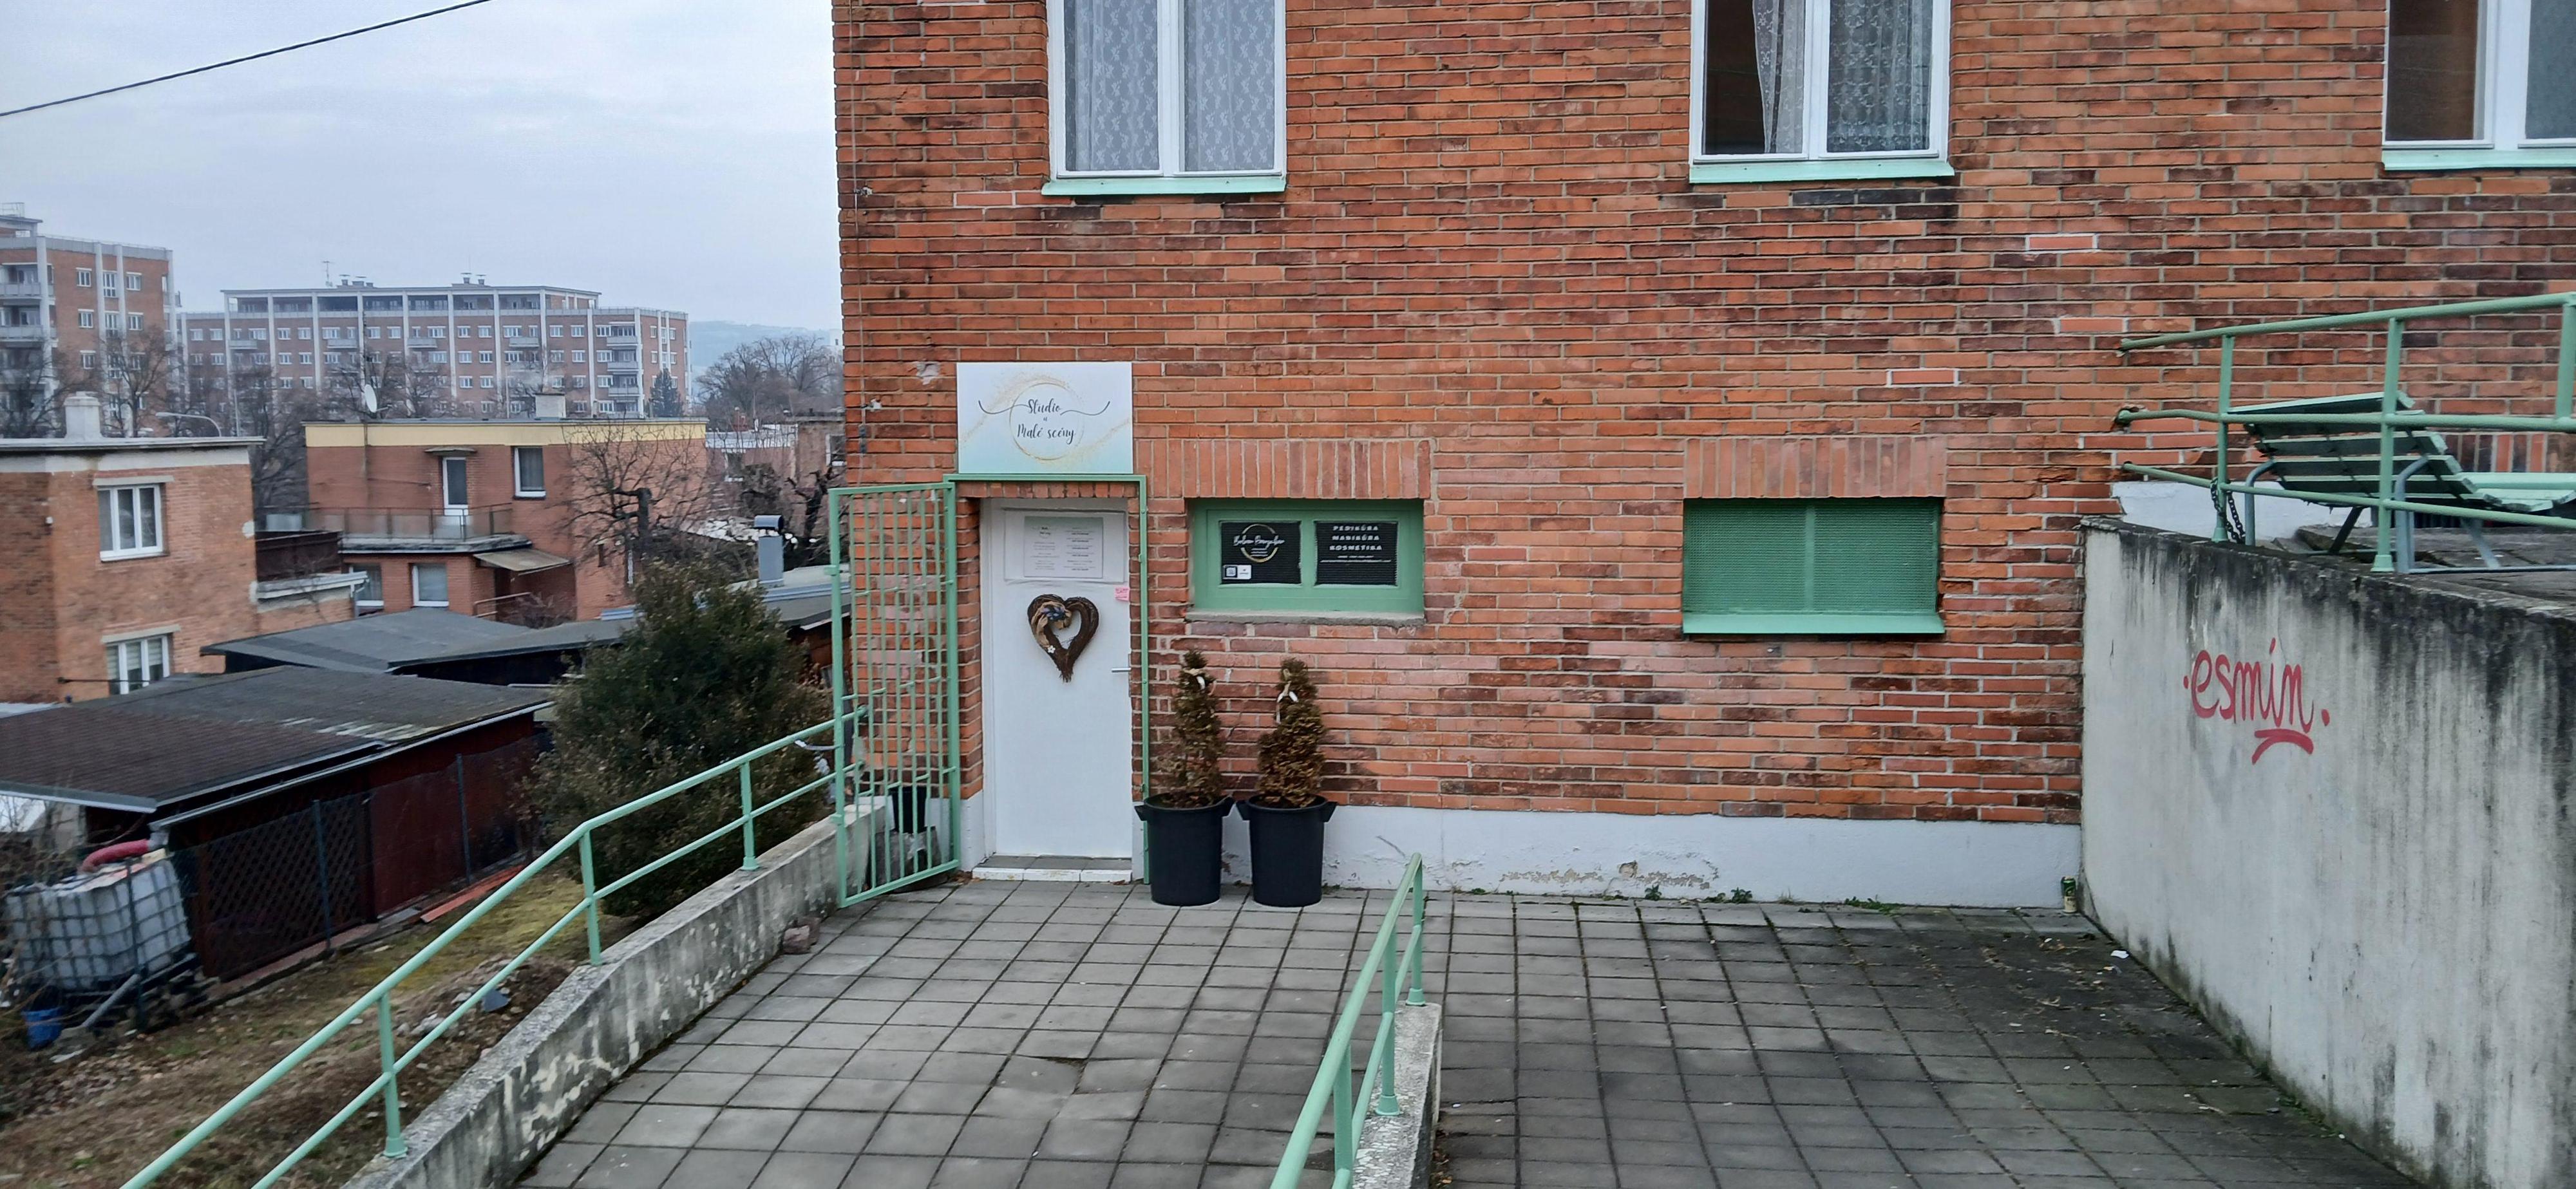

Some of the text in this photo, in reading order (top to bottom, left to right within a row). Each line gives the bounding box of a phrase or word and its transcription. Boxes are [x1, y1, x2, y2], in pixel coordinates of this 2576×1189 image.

[1028, 398, 1061, 414] Studio
[1018, 424, 1074, 445] Malé scény
